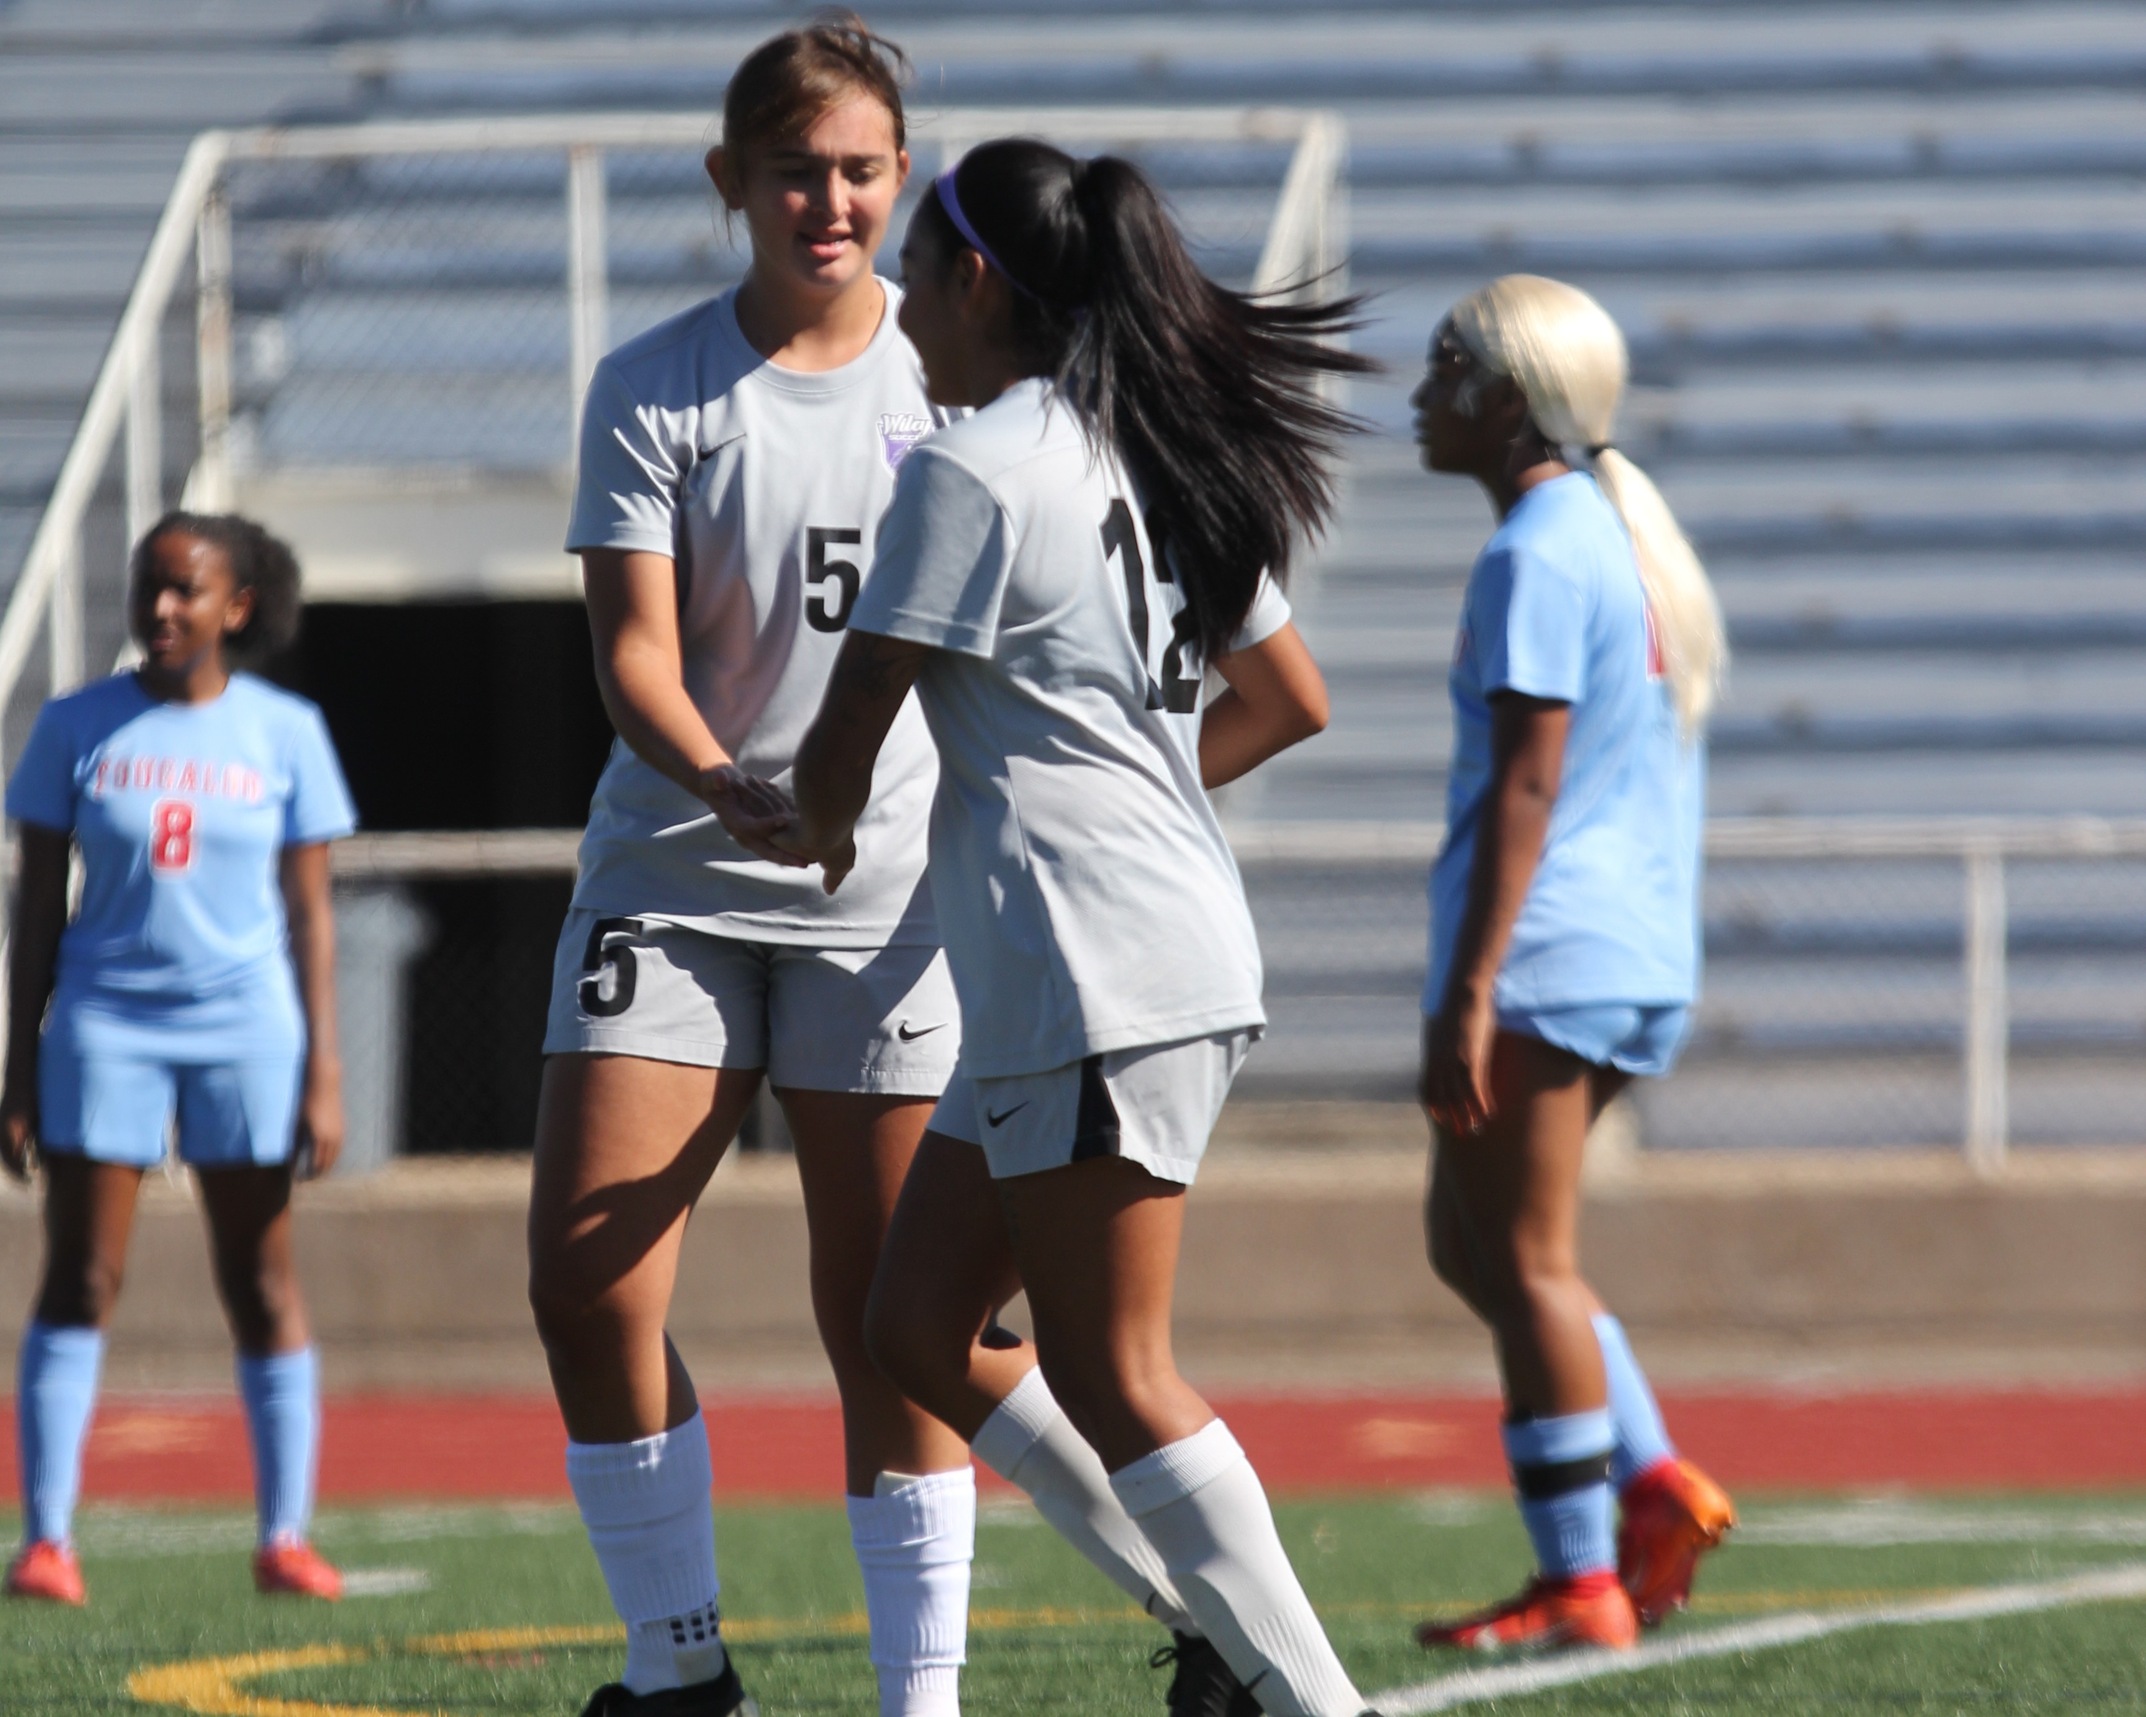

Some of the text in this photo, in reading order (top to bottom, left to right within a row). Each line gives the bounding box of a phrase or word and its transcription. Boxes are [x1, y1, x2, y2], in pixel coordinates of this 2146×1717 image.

[805, 526, 861, 633] 5
[153, 801, 194, 870] 8
[580, 917, 643, 1018] 5
